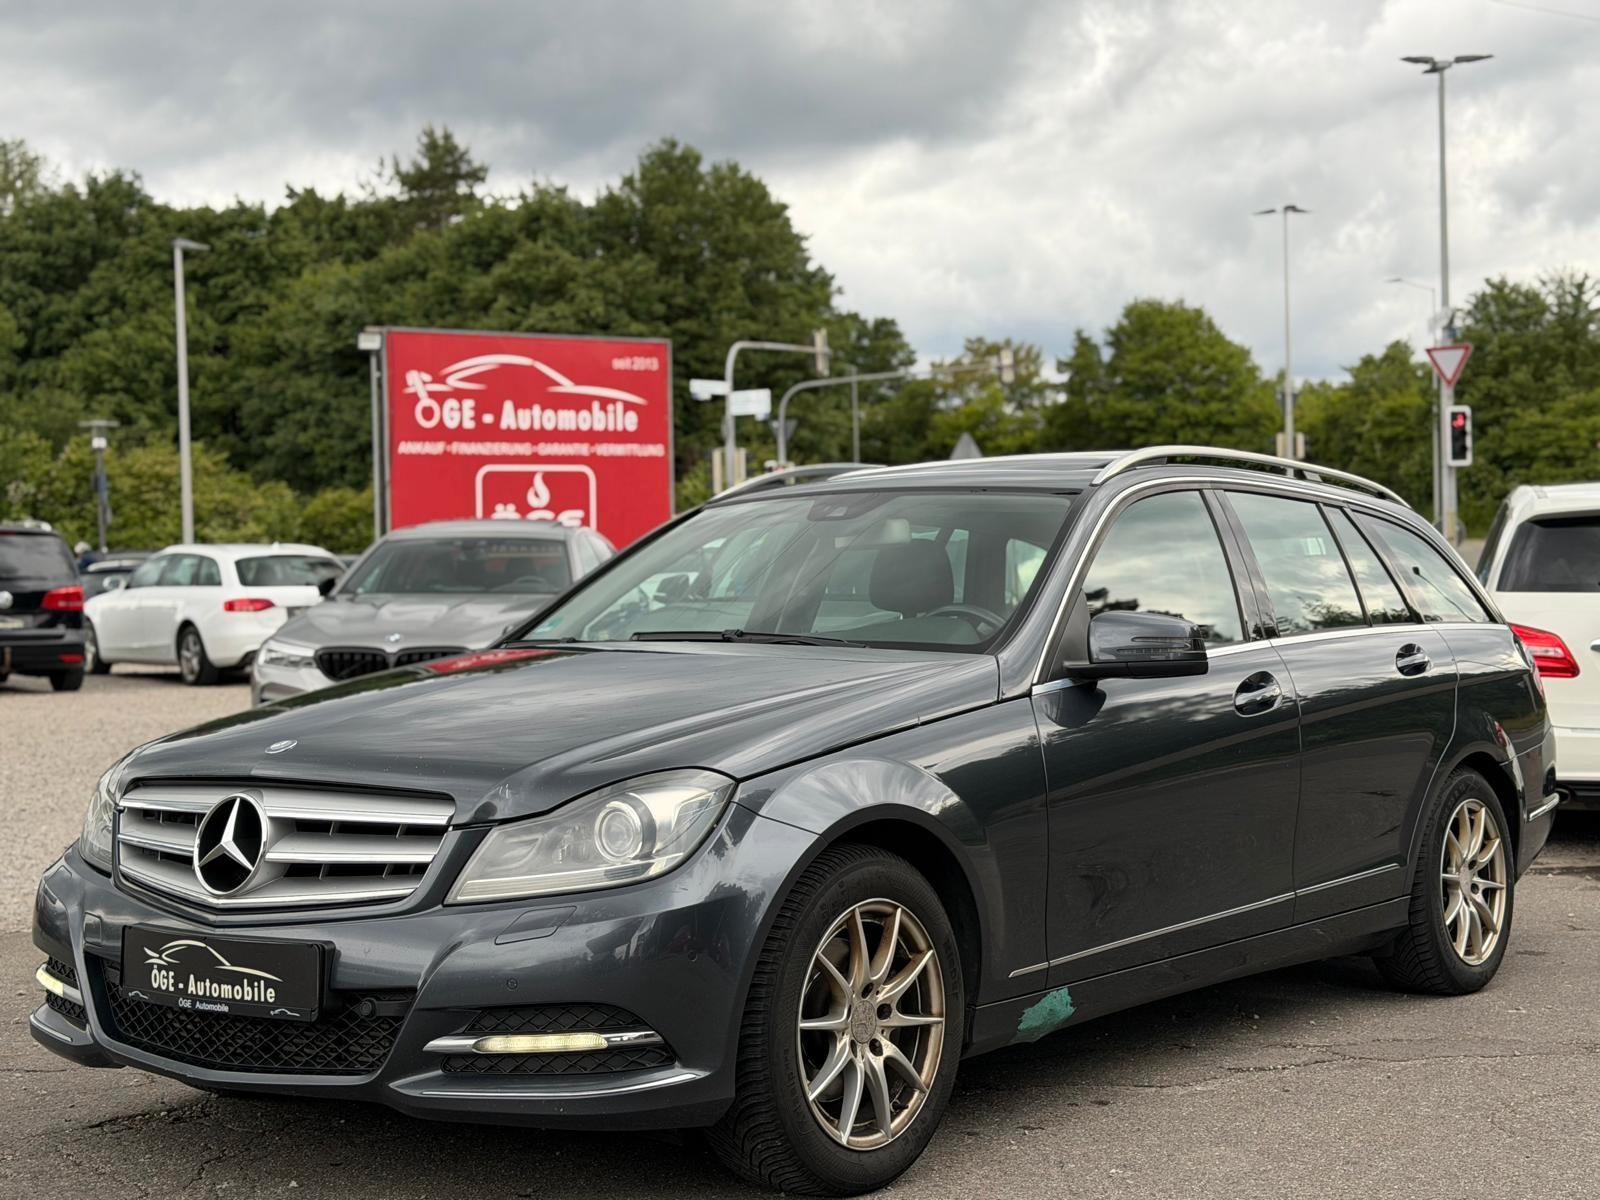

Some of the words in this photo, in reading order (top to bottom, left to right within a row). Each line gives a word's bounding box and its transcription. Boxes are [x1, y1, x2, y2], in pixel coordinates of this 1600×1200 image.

[499, 399, 639, 432] Automobile
[151, 964, 175, 992] ÖGE
[187, 973, 276, 1003] Automobile
[195, 1000, 230, 1013] Automobile
